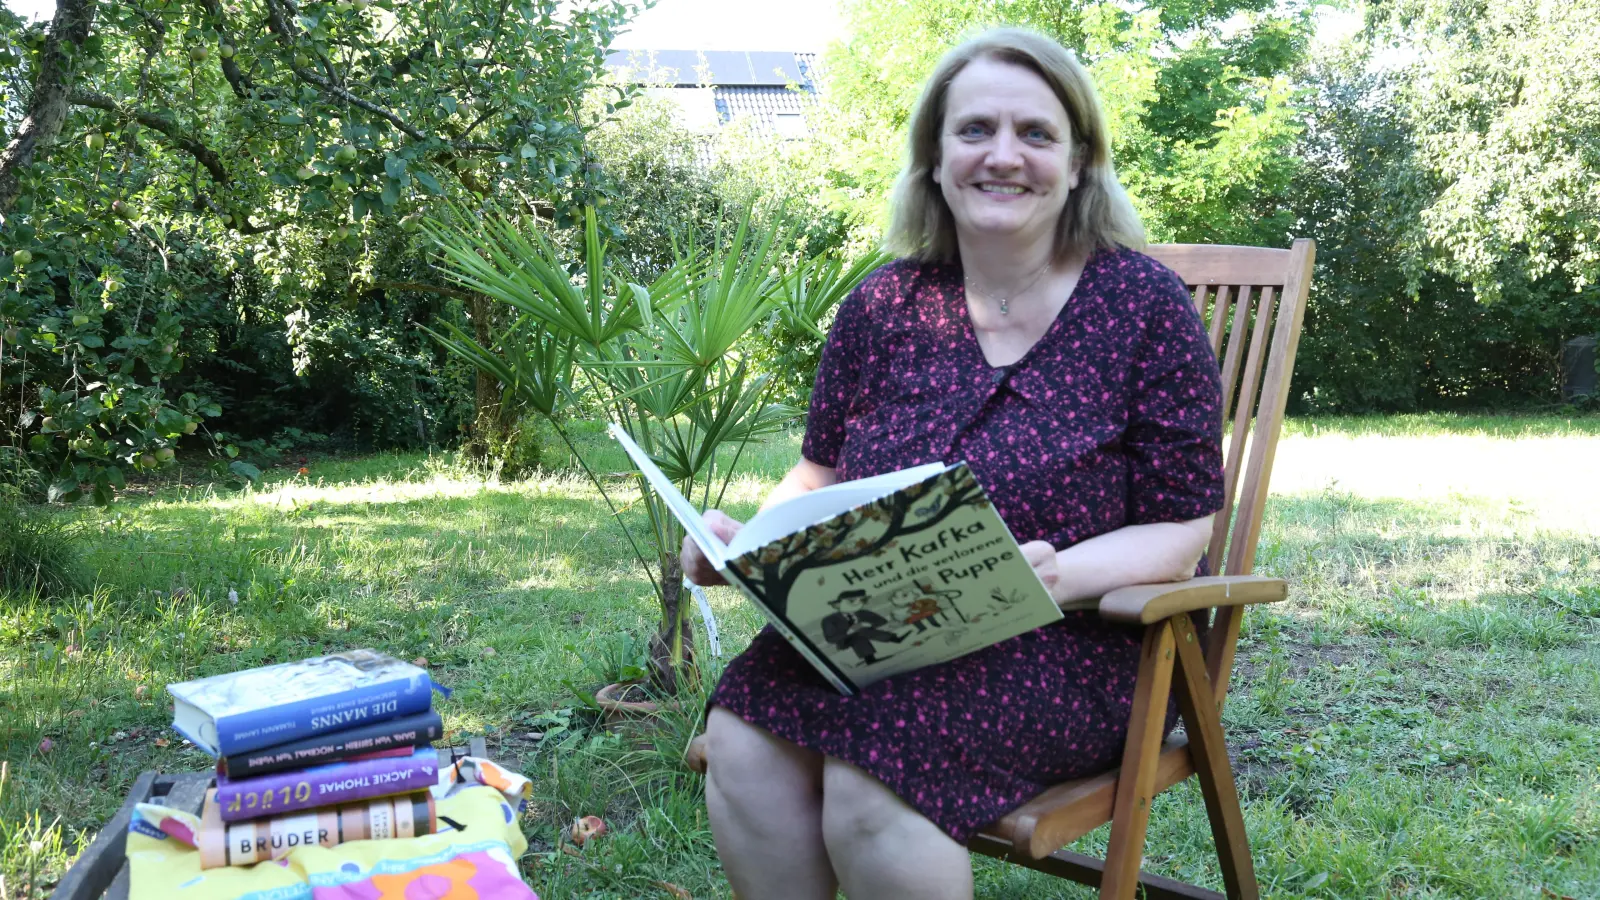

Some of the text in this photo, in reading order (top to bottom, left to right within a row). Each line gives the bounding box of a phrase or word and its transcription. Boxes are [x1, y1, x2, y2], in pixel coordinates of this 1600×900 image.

[842, 520, 986, 585] Herr Kafka
[873, 536, 1004, 589] und die verlorene
[938, 550, 1014, 584] Puppe
[311, 699, 397, 730] DIE MANNS
[227, 780, 312, 813] GLÜCK
[319, 768, 414, 794] JACKIE THOMAE
[240, 828, 329, 854] BRÜDER
